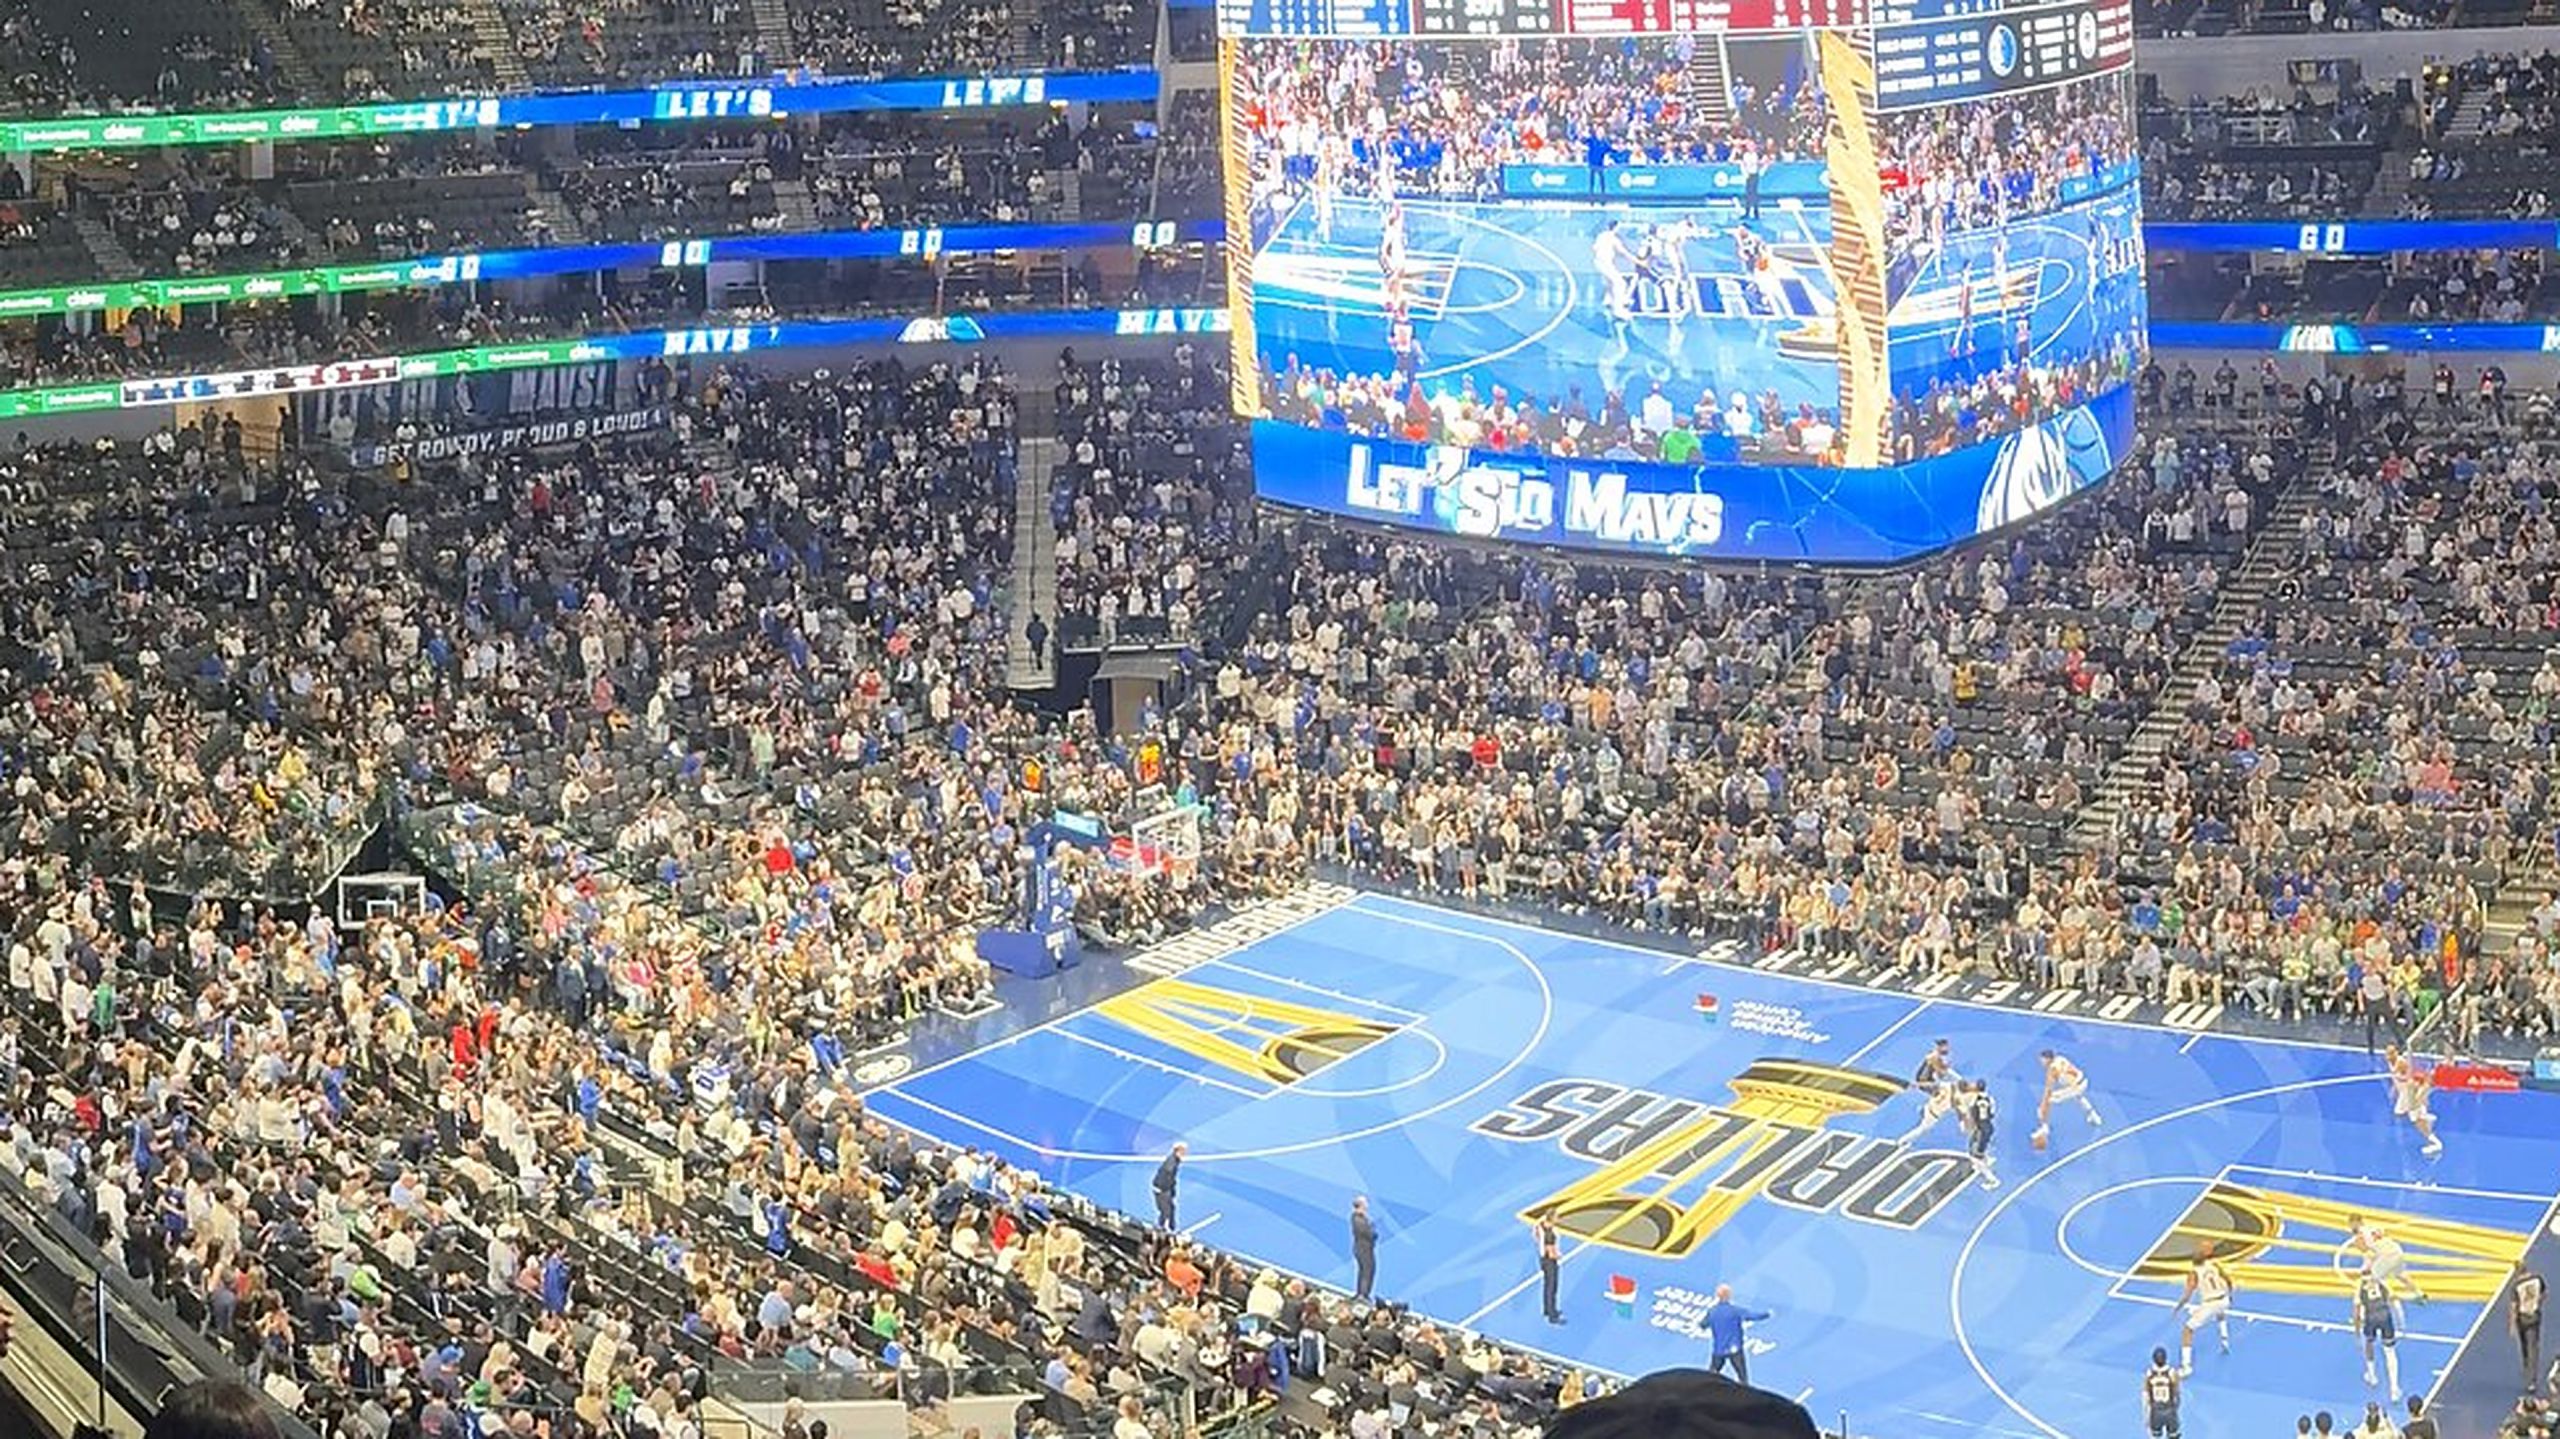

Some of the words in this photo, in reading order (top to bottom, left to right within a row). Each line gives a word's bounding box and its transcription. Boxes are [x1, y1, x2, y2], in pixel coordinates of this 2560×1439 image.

[668, 89, 773, 118] LET'S
[943, 78, 1045, 107] LET'S
[2299, 224, 2346, 251] GO
[1116, 309, 1230, 335] MAVS
[663, 328, 751, 355] MAVS
[1565, 470, 1724, 547] MAVS
[1467, 1077, 1984, 1231] DALLAS
